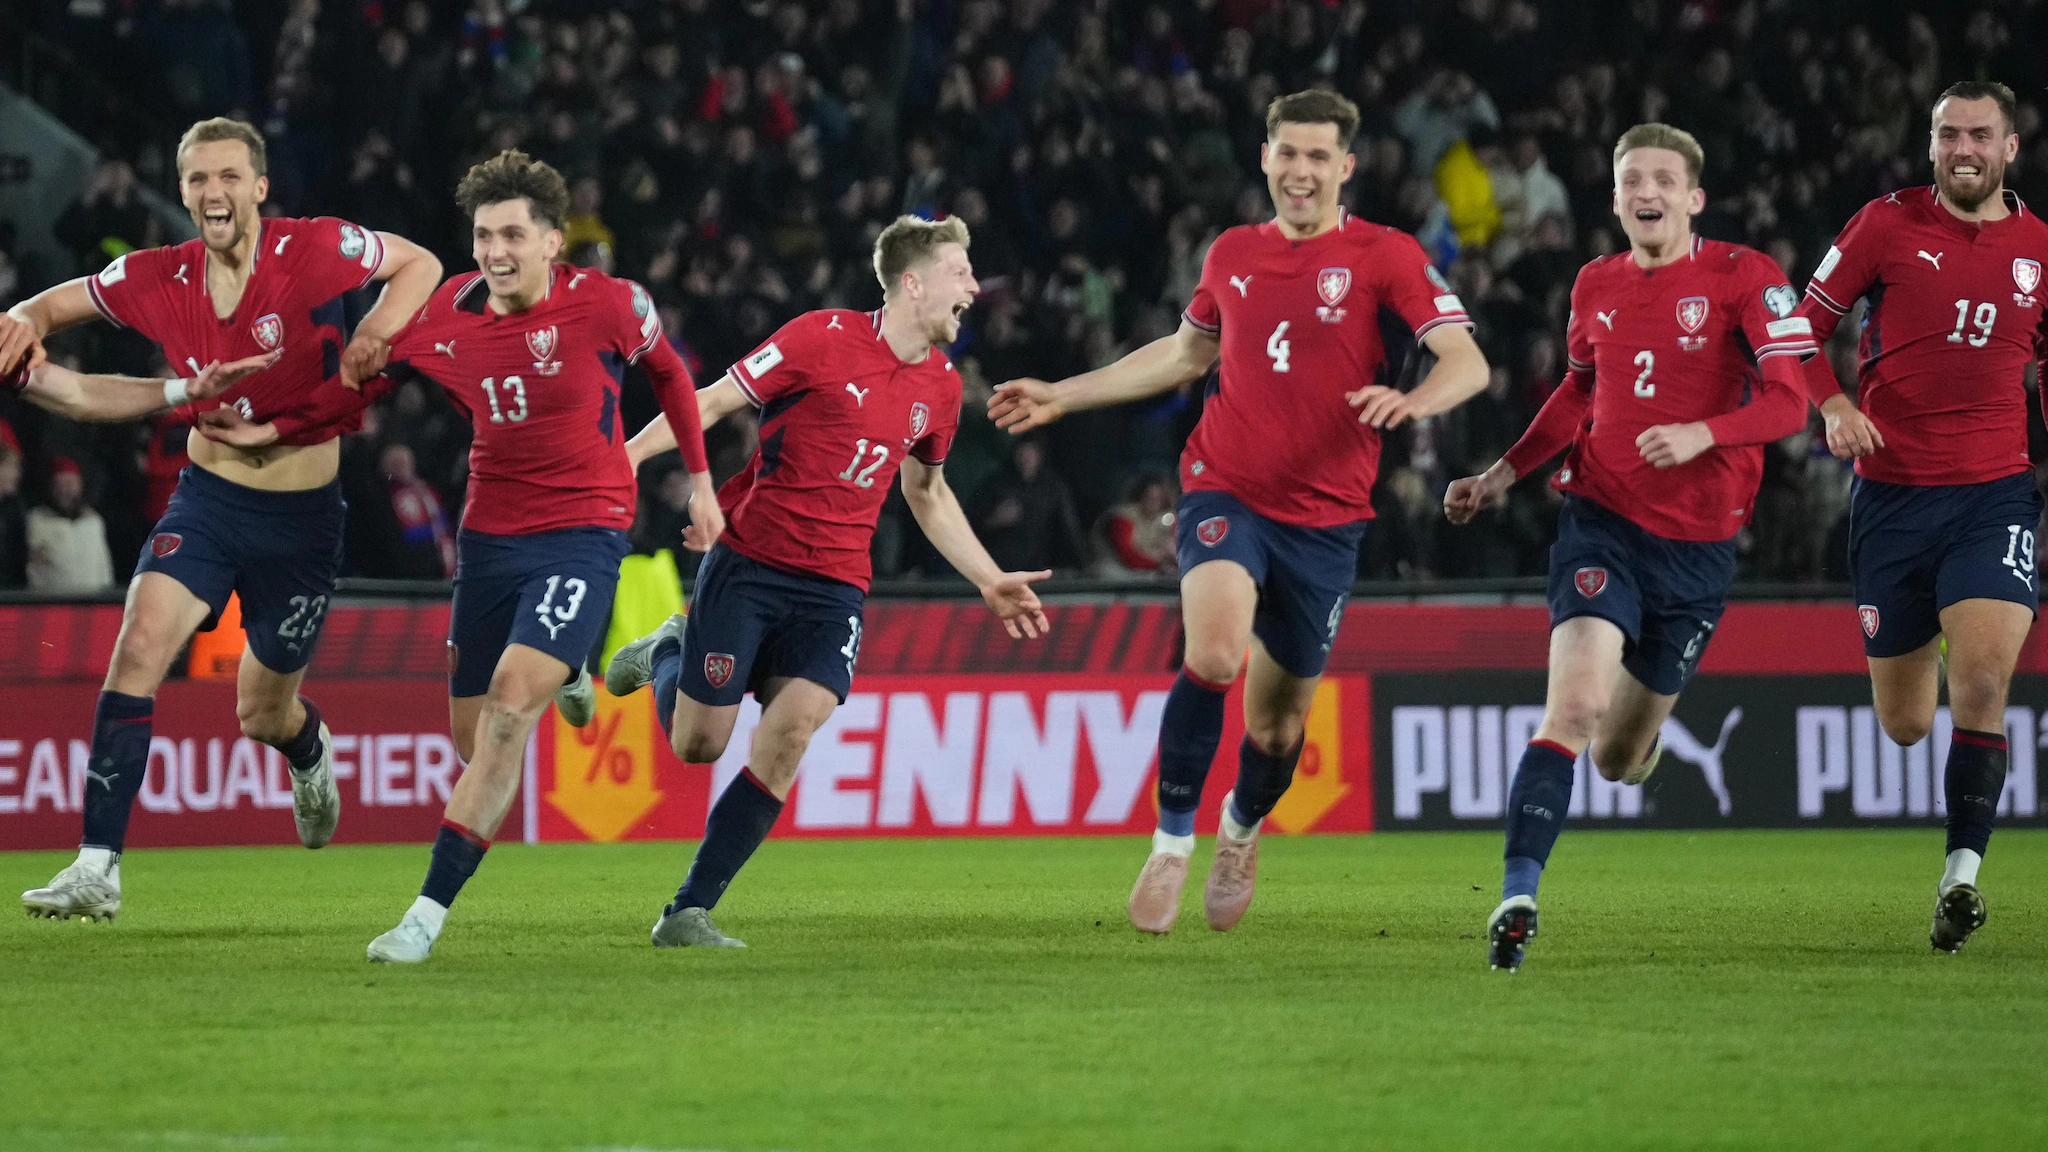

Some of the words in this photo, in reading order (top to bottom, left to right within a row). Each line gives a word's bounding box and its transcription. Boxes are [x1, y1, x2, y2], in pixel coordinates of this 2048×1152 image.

[1267, 320, 1290, 373] 4
[1947, 299, 1997, 347] 19
[1634, 350, 1655, 398] 2
[481, 376, 528, 423] 13
[839, 438, 889, 488] 12
[2002, 524, 2034, 572] 19
[535, 574, 587, 622] 13
[840, 615, 862, 666] 1
[138, 733, 467, 813] QUALFIER
